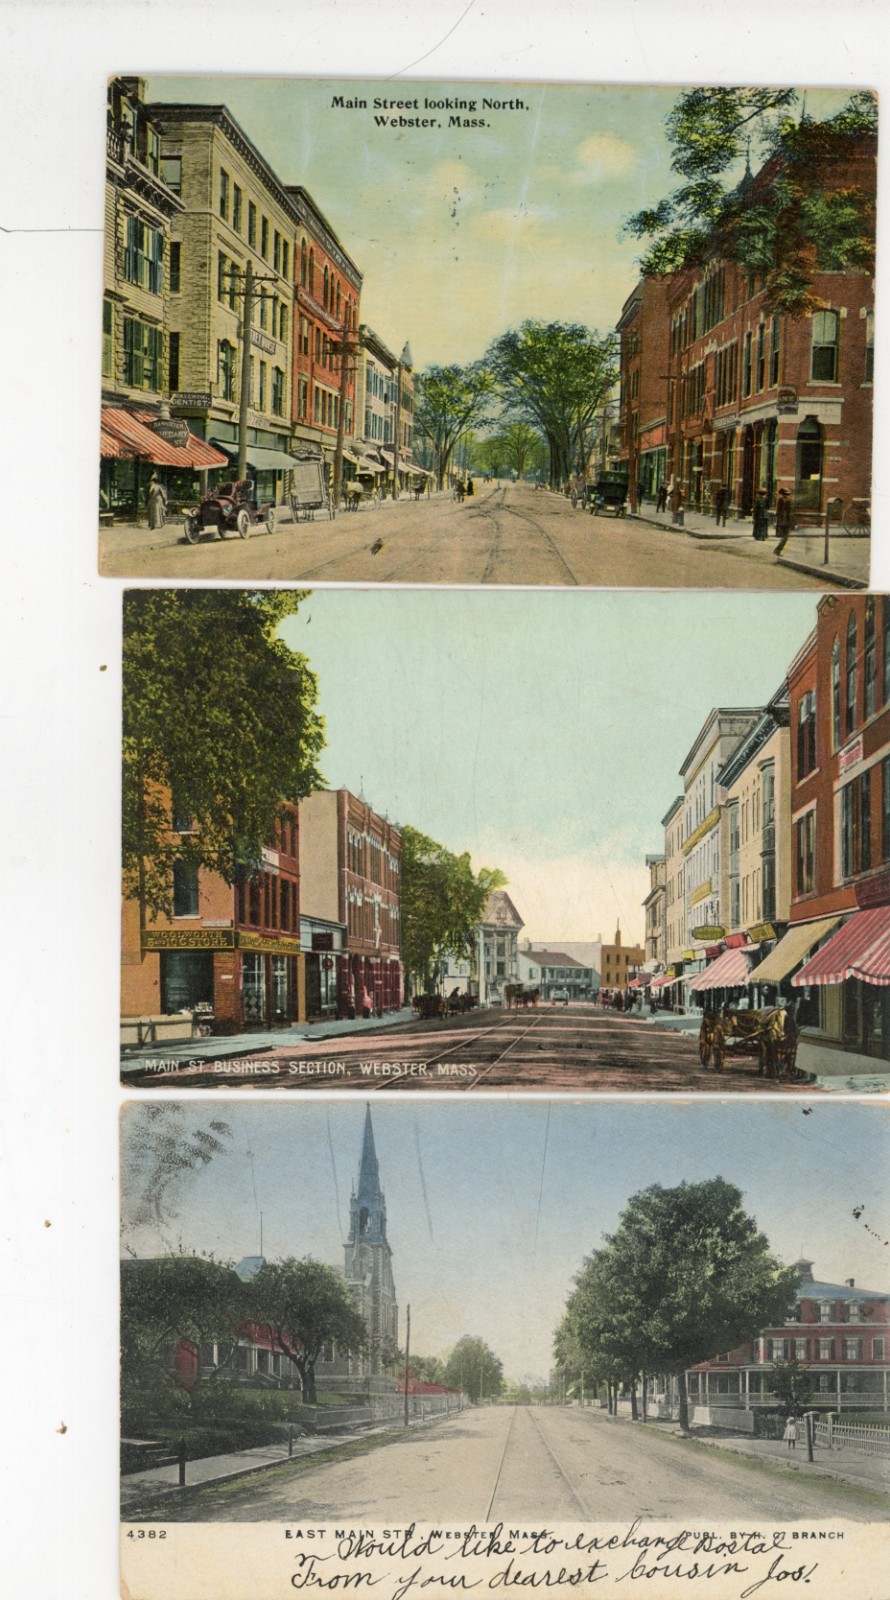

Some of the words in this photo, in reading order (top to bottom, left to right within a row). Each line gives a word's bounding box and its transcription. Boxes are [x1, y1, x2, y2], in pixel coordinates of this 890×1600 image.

[331, 96, 367, 109] Main
[373, 98, 419, 109] Street
[424, 97, 477, 112] looking
[482, 98, 530, 110] North,
[374, 115, 442, 128] Webster,
[448, 116, 491, 128] Mass.
[152, 931, 223, 939] WOOLWORTH
[188, 937, 228, 947] STORE
[144, 1059, 180, 1072] MAIN
[214, 1060, 280, 1074] BUSINESS
[288, 1061, 351, 1076] SECTION,
[360, 1062, 433, 1078] WEBSTER,
[126, 1530, 168, 1540] 4382
[285, 1530, 327, 1539] EAST
[334, 1530, 374, 1539] MAIN
[337, 1522, 445, 1561] Would
[444, 1522, 516, 1560] like
[519, 1529, 563, 1555] to
[564, 1517, 694, 1561] exchange
[686, 1531, 722, 1540] PUBL.
[730, 1531, 745, 1540] BY
[792, 1531, 844, 1540] BRANCH
[291, 1552, 392, 1590] From
[488, 1558, 608, 1590] dearest
